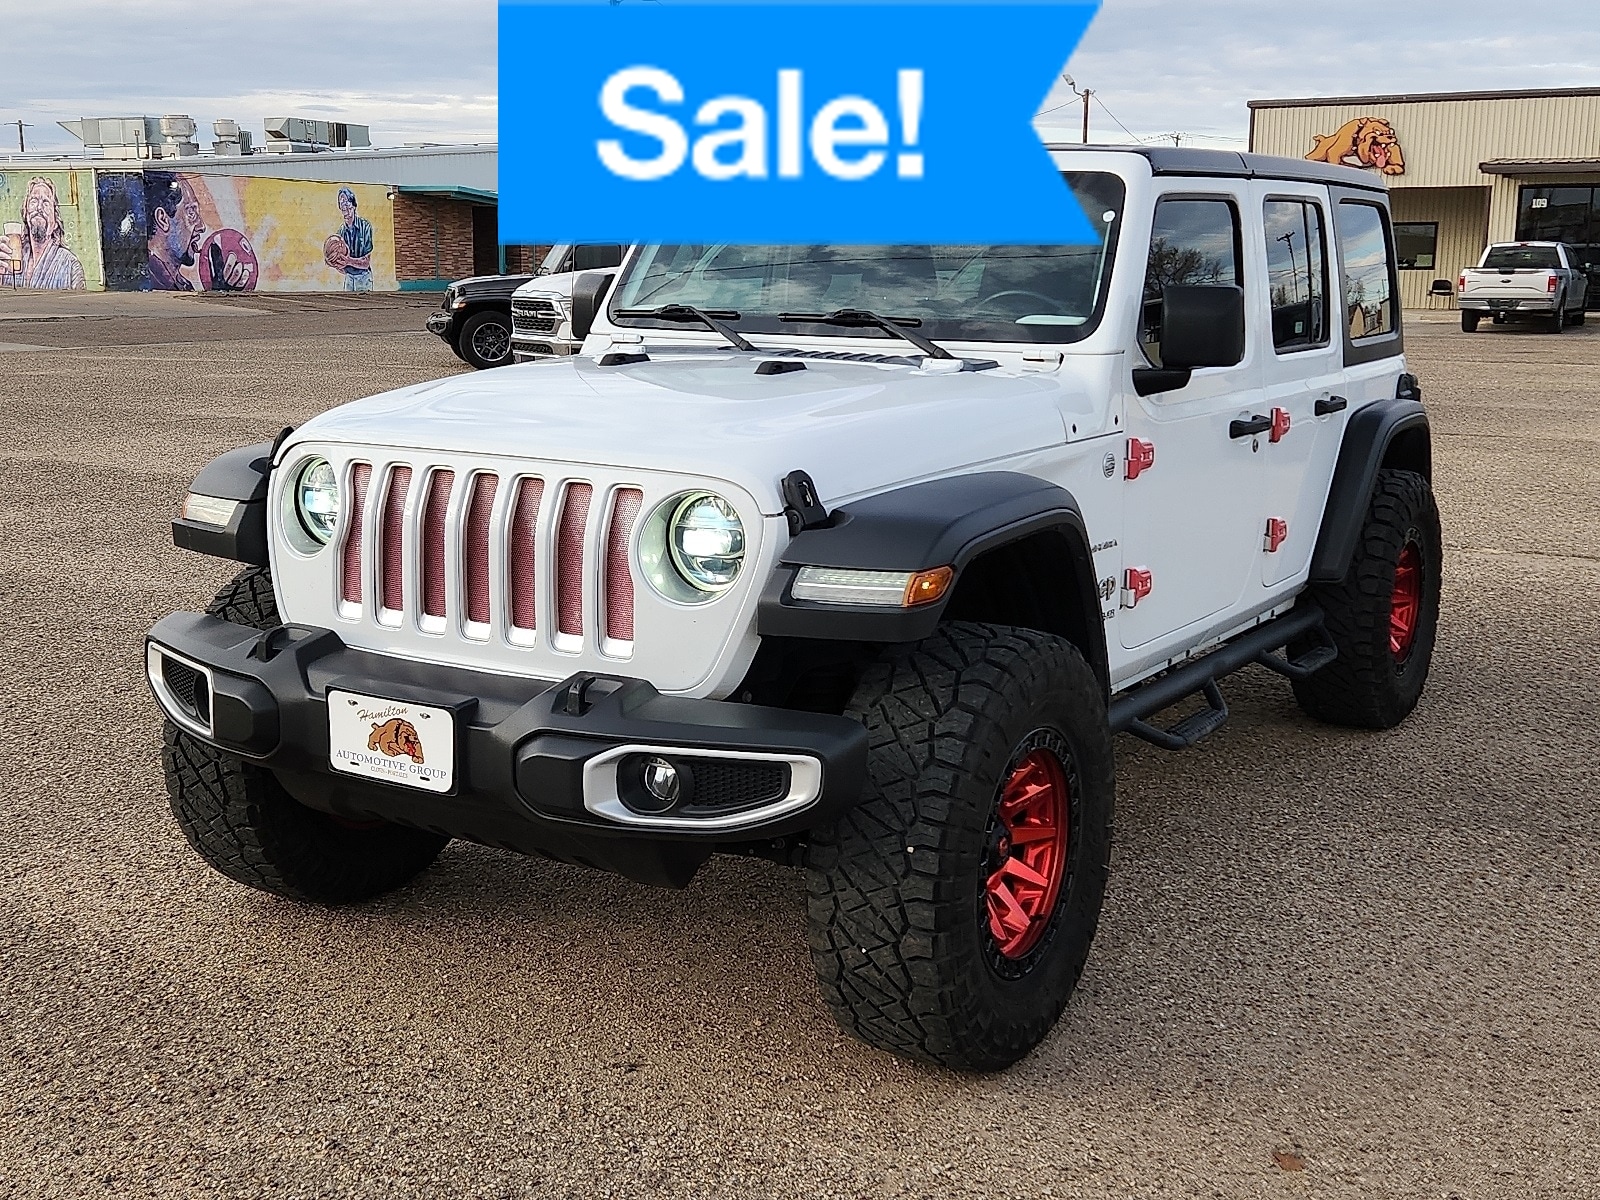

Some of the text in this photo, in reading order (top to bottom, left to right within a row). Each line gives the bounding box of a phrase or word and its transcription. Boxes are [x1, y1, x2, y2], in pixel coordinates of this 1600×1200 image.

[517, 309, 537, 318] RAM
[357, 705, 408, 722] Hamilton
[336, 749, 447, 779] AUTOMOTIVE GROUP
